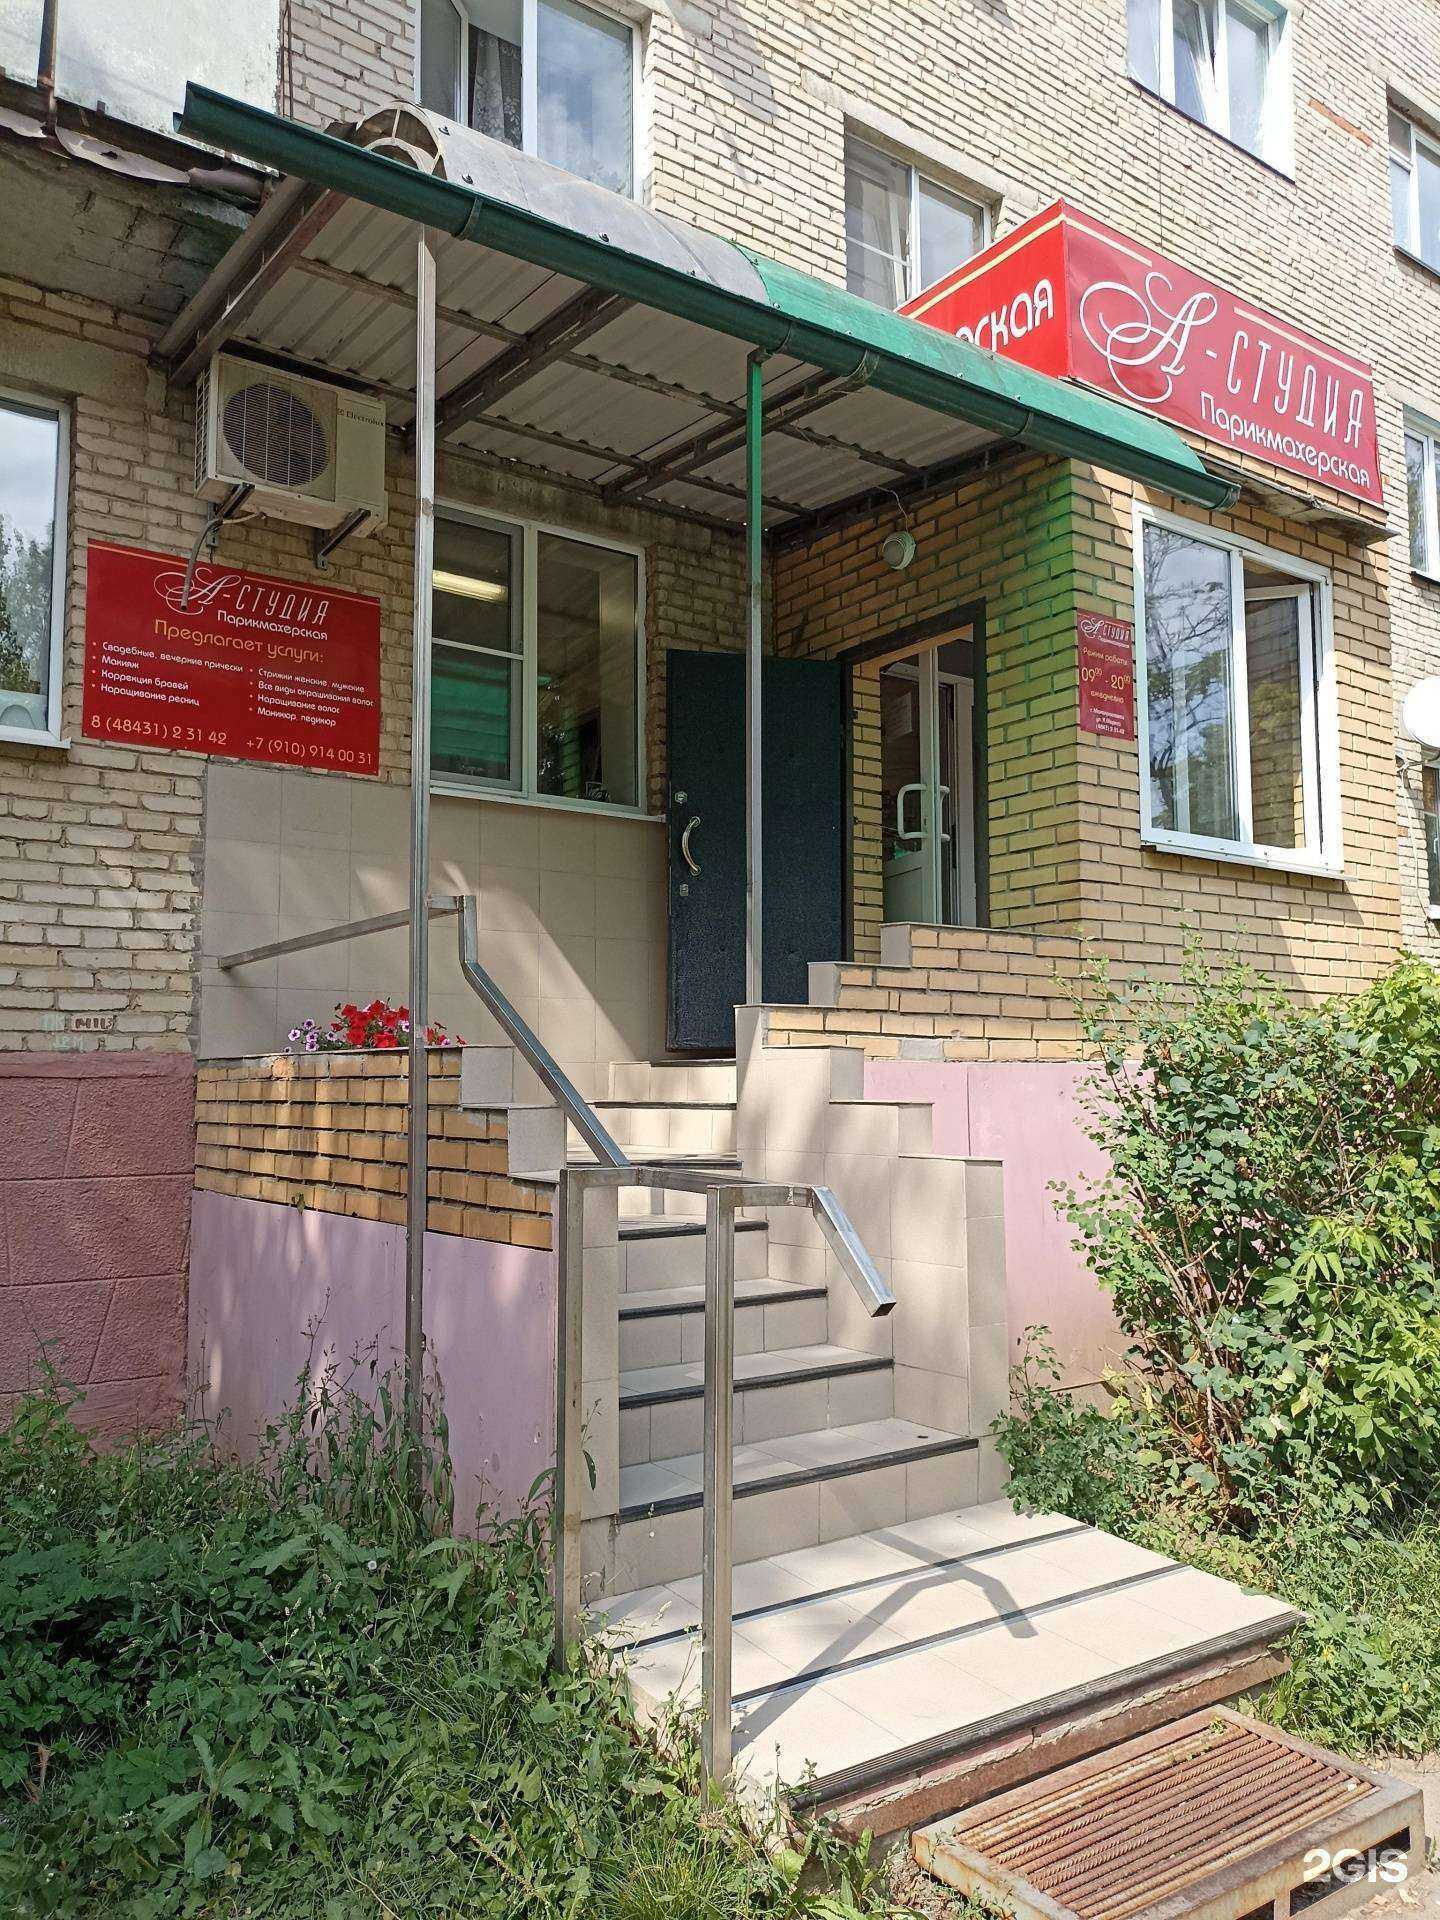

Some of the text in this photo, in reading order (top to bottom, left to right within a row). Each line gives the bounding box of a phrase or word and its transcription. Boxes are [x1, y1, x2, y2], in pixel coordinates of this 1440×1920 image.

[346, 410, 385, 427] Electrolux
[1200, 391, 1370, 488] Парикмахерская
[217, 610, 328, 640] Парикмахерская
[154, 619, 324, 663] Предлагает услуги:
[102, 655, 139, 669] Макияж
[160, 653, 202, 667] вечерние
[205, 660, 243, 672] прически
[101, 669, 189, 691] Коррекция бровей
[258, 668, 292, 680] Стрижки
[332, 682, 364, 693] мужские
[101, 683, 200, 706] Наращивание ресниц
[257, 694, 340, 714] Наращивание волос
[258, 681, 374, 707] Все виды окрашивания волос
[91, 715, 227, 745] 8 (48431) 2 31 42
[300, 715, 336, 727] педикюр
[246, 737, 371, 765] +7 (910) 914 00 31
